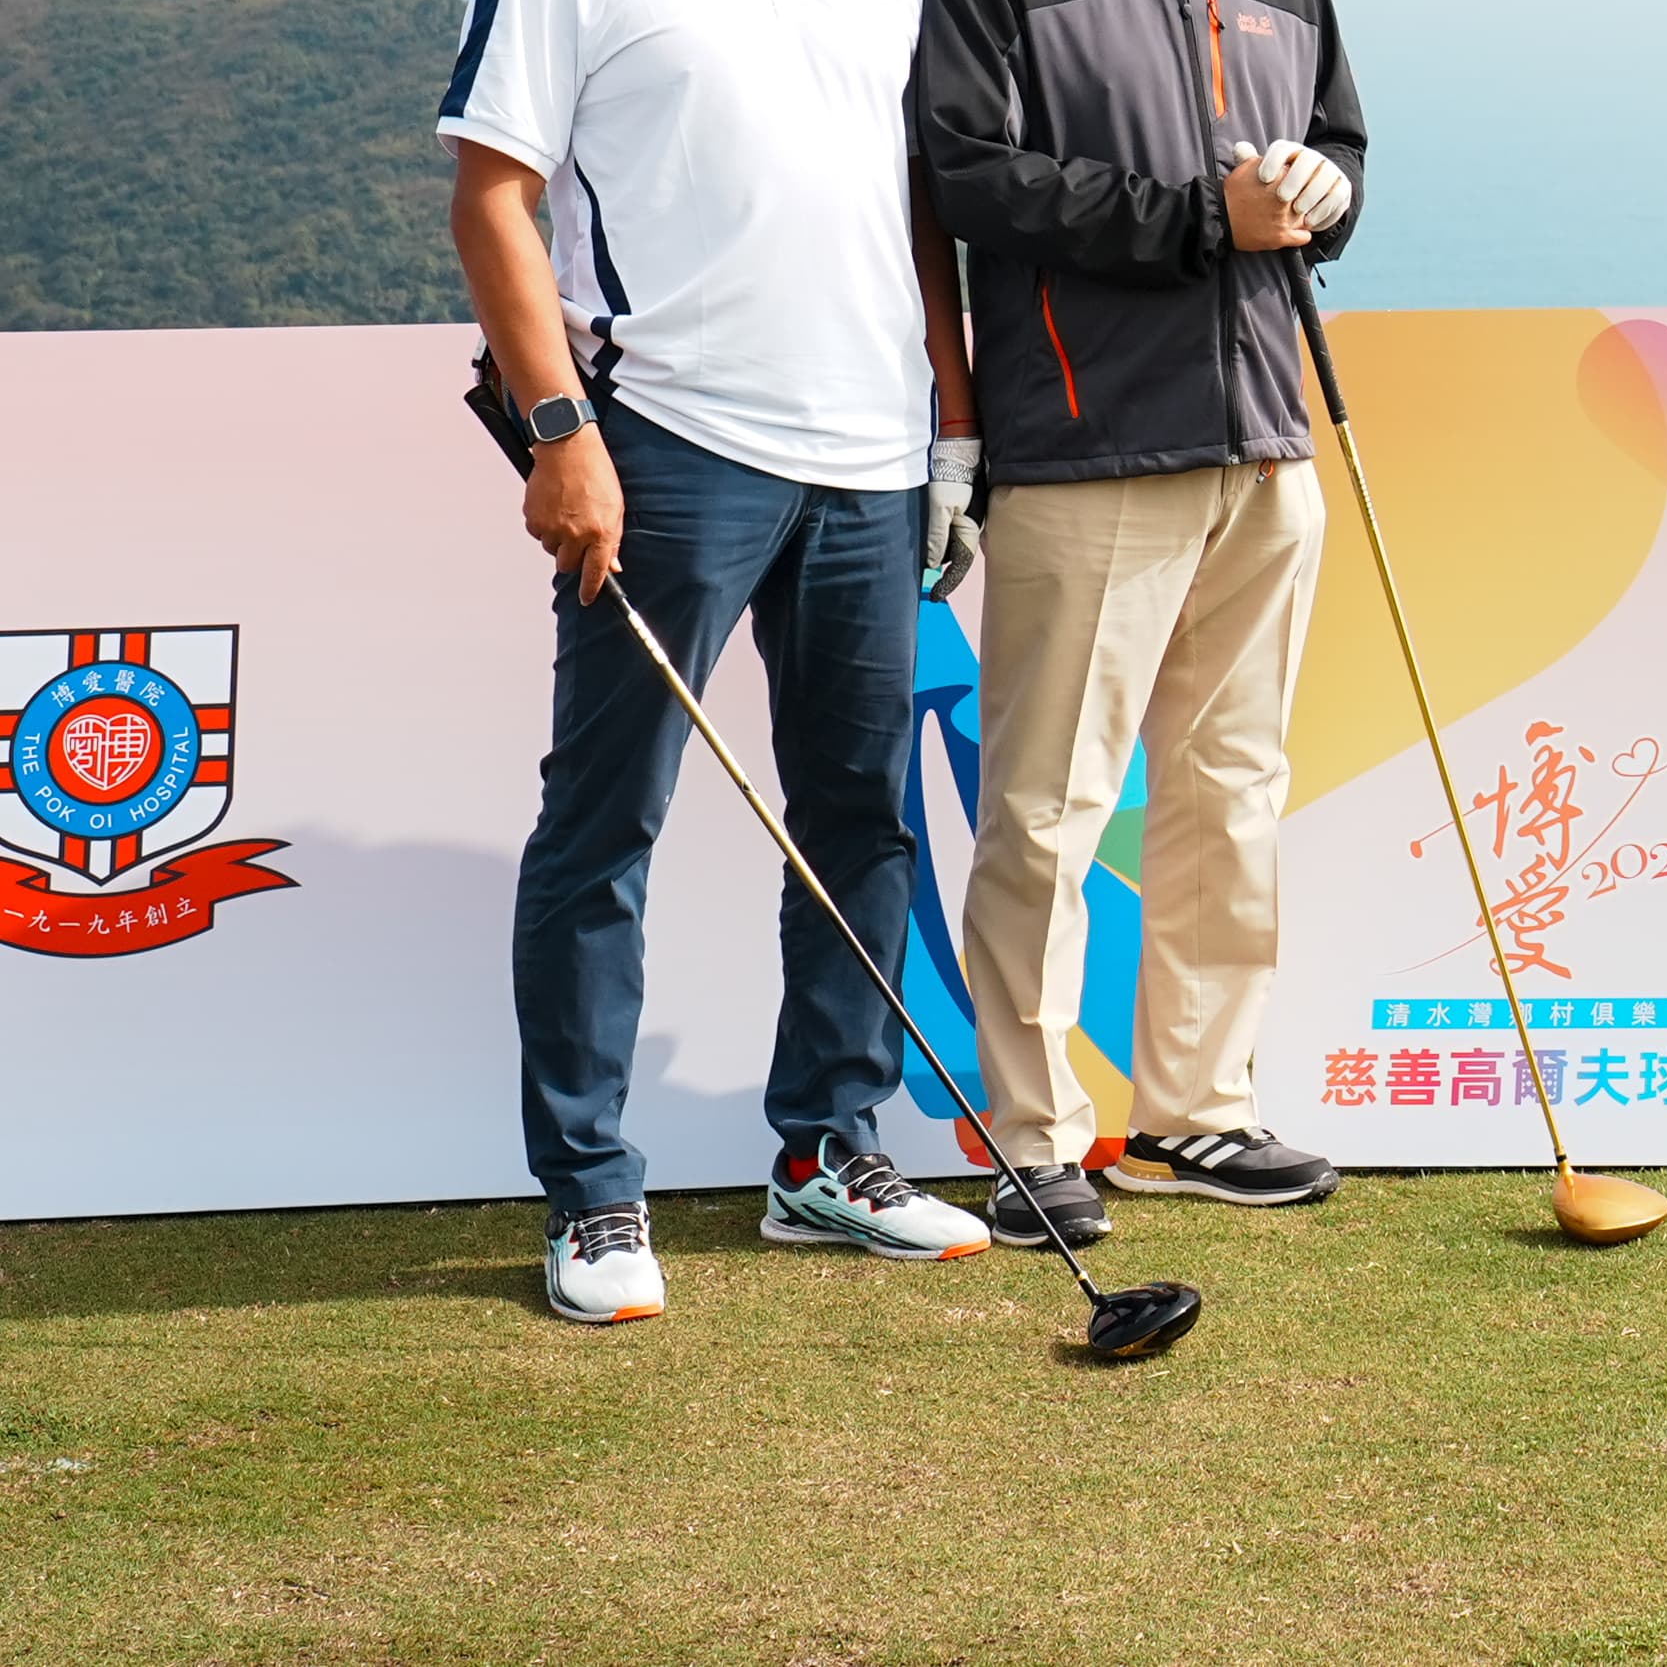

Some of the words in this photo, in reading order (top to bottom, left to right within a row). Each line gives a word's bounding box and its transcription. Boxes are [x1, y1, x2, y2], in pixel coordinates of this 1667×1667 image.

[50, 669, 166, 708] 博愛醫院
[22, 732, 41, 775] THE
[34, 785, 77, 823] POK
[89, 813, 112, 829] OI
[129, 726, 191, 822] HOSPITAL
[4, 896, 198, 935] 一九一九年創立
